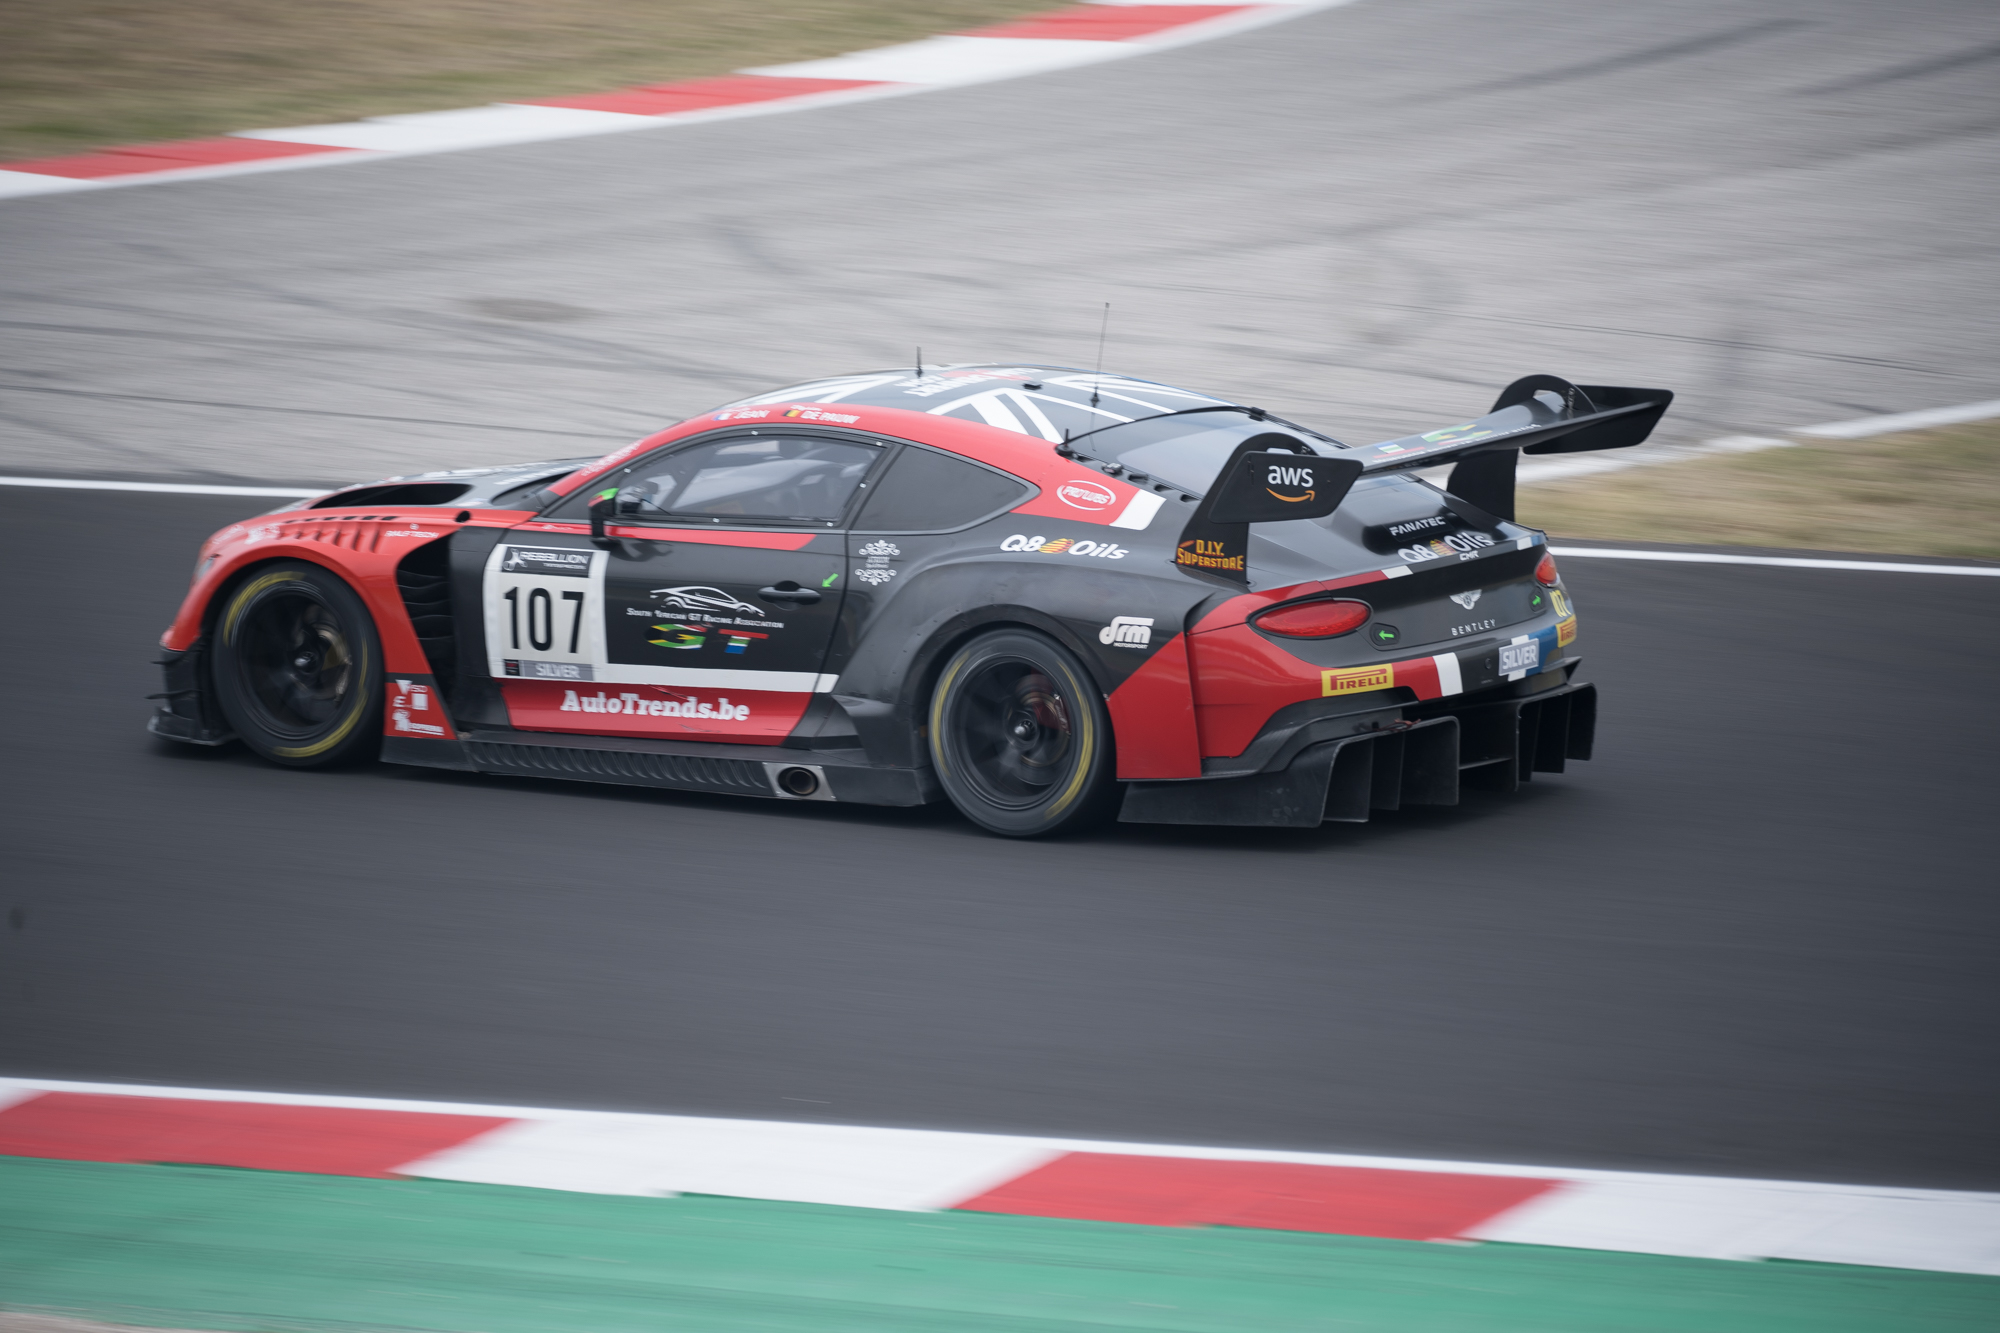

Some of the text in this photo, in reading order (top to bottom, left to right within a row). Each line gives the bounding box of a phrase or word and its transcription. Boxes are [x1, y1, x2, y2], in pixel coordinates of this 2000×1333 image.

[1267, 465, 1314, 488] aws
[1388, 515, 1446, 537] FANATEC
[520, 551, 589, 564] REBELLION
[999, 533, 1130, 560] Q8 Oils
[1176, 546, 1245, 572] SUPERSTORE
[1397, 531, 1496, 563] Q8 Oils
[502, 586, 586, 654] 107
[1451, 618, 1496, 636] BENTLEY
[1501, 644, 1538, 670] SILVER
[533, 662, 581, 679] SILVER
[1329, 667, 1388, 691] PIRELLI
[560, 689, 751, 722] AutoTrends.be
